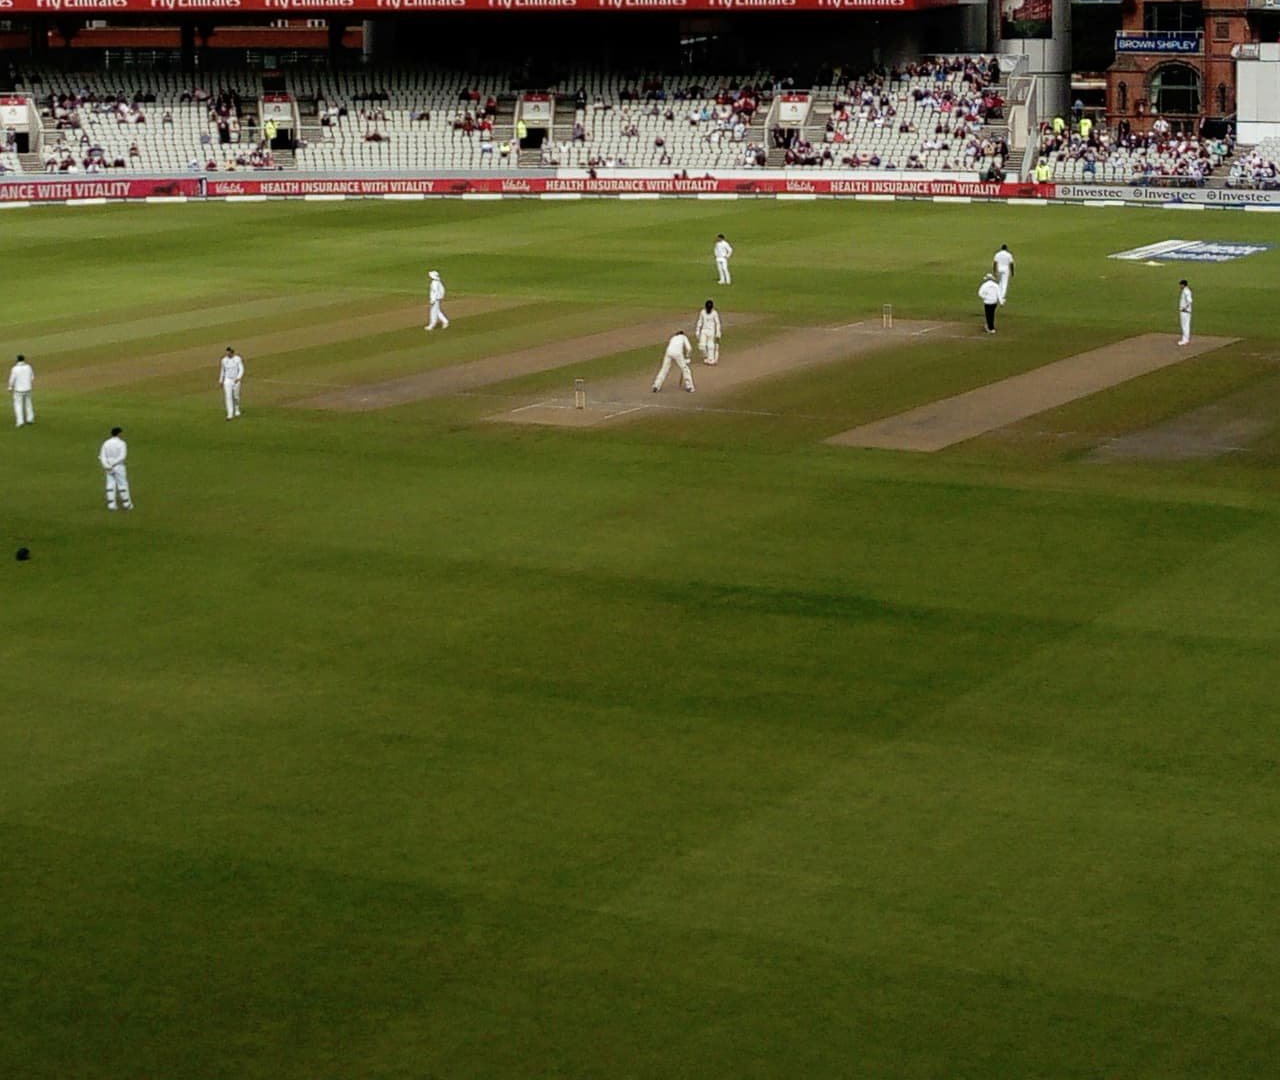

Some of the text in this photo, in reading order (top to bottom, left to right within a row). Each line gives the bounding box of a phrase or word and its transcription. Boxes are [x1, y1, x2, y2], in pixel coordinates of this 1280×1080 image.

[1119, 40, 1197, 50] BROWN SHIPLEY
[37, 182, 72, 199] WITH
[74, 182, 131, 197] VITALITY
[260, 181, 434, 194] HEALTH INSURANCE WITH VITALITY
[546, 181, 718, 191] HEALTH INSURANCE WITH VITALITY
[830, 181, 1001, 195] HEALTH INSURANCE WITH VITALITY
[1072, 187, 1123, 199] Investec
[1144, 189, 1196, 201] Investec
[1218, 191, 1270, 203] Investec
